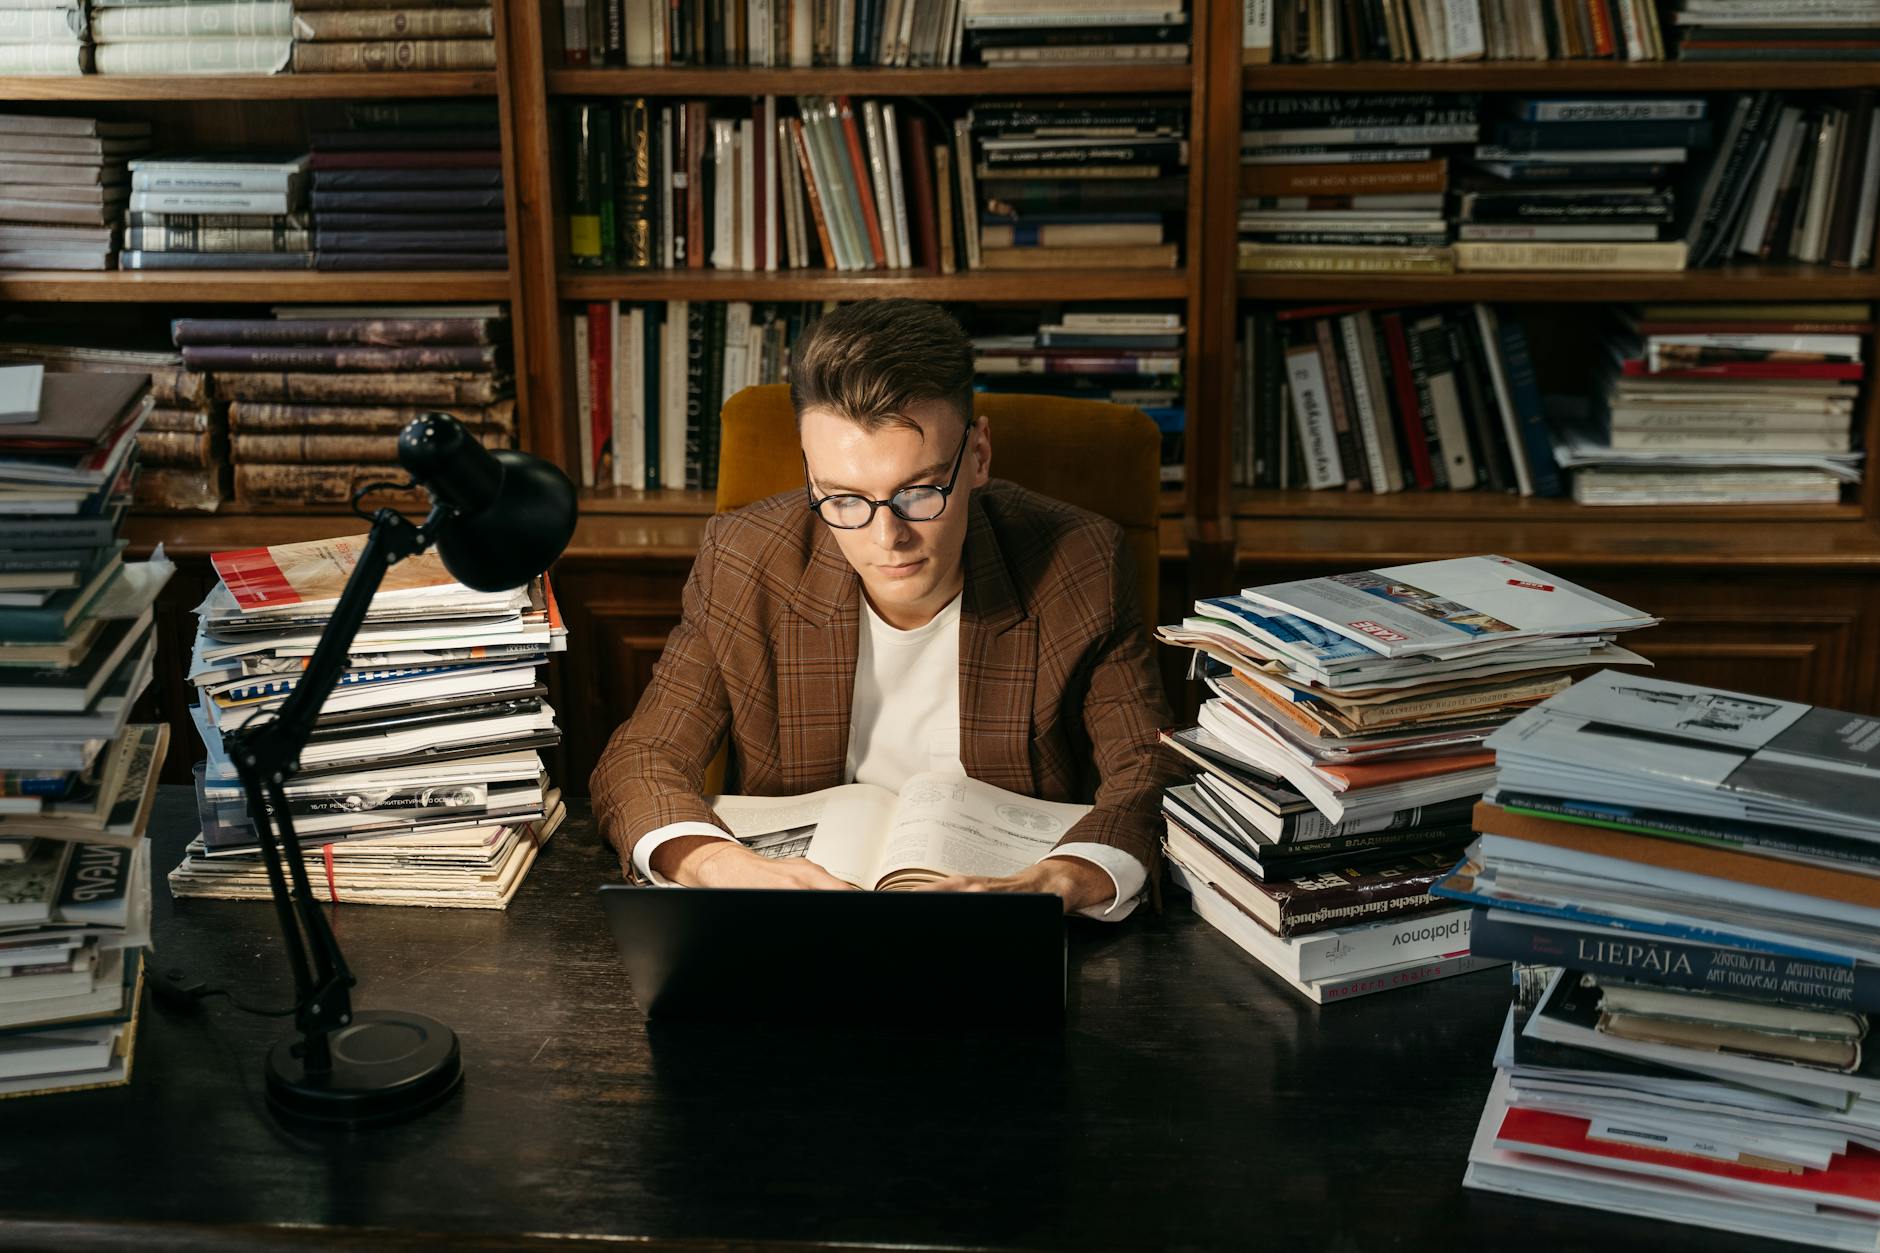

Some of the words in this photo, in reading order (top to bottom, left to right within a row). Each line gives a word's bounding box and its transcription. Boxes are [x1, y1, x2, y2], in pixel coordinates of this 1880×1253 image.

[1423, 109, 1477, 125] PARIS
[1557, 102, 1652, 119] architecture
[1354, 620, 1405, 642] KABE
[1286, 900, 1388, 924] Einrichtungsbuch
[1392, 919, 1459, 947] platonov
[1577, 938, 1693, 976] LIEPĀJA
[1327, 979, 1385, 999] modern
[1392, 964, 1441, 985] chairs
[1706, 970, 1727, 983] ART
[1728, 972, 1779, 991] NOUVEAU
[1781, 978, 1856, 1002] ARCHITECTURE
